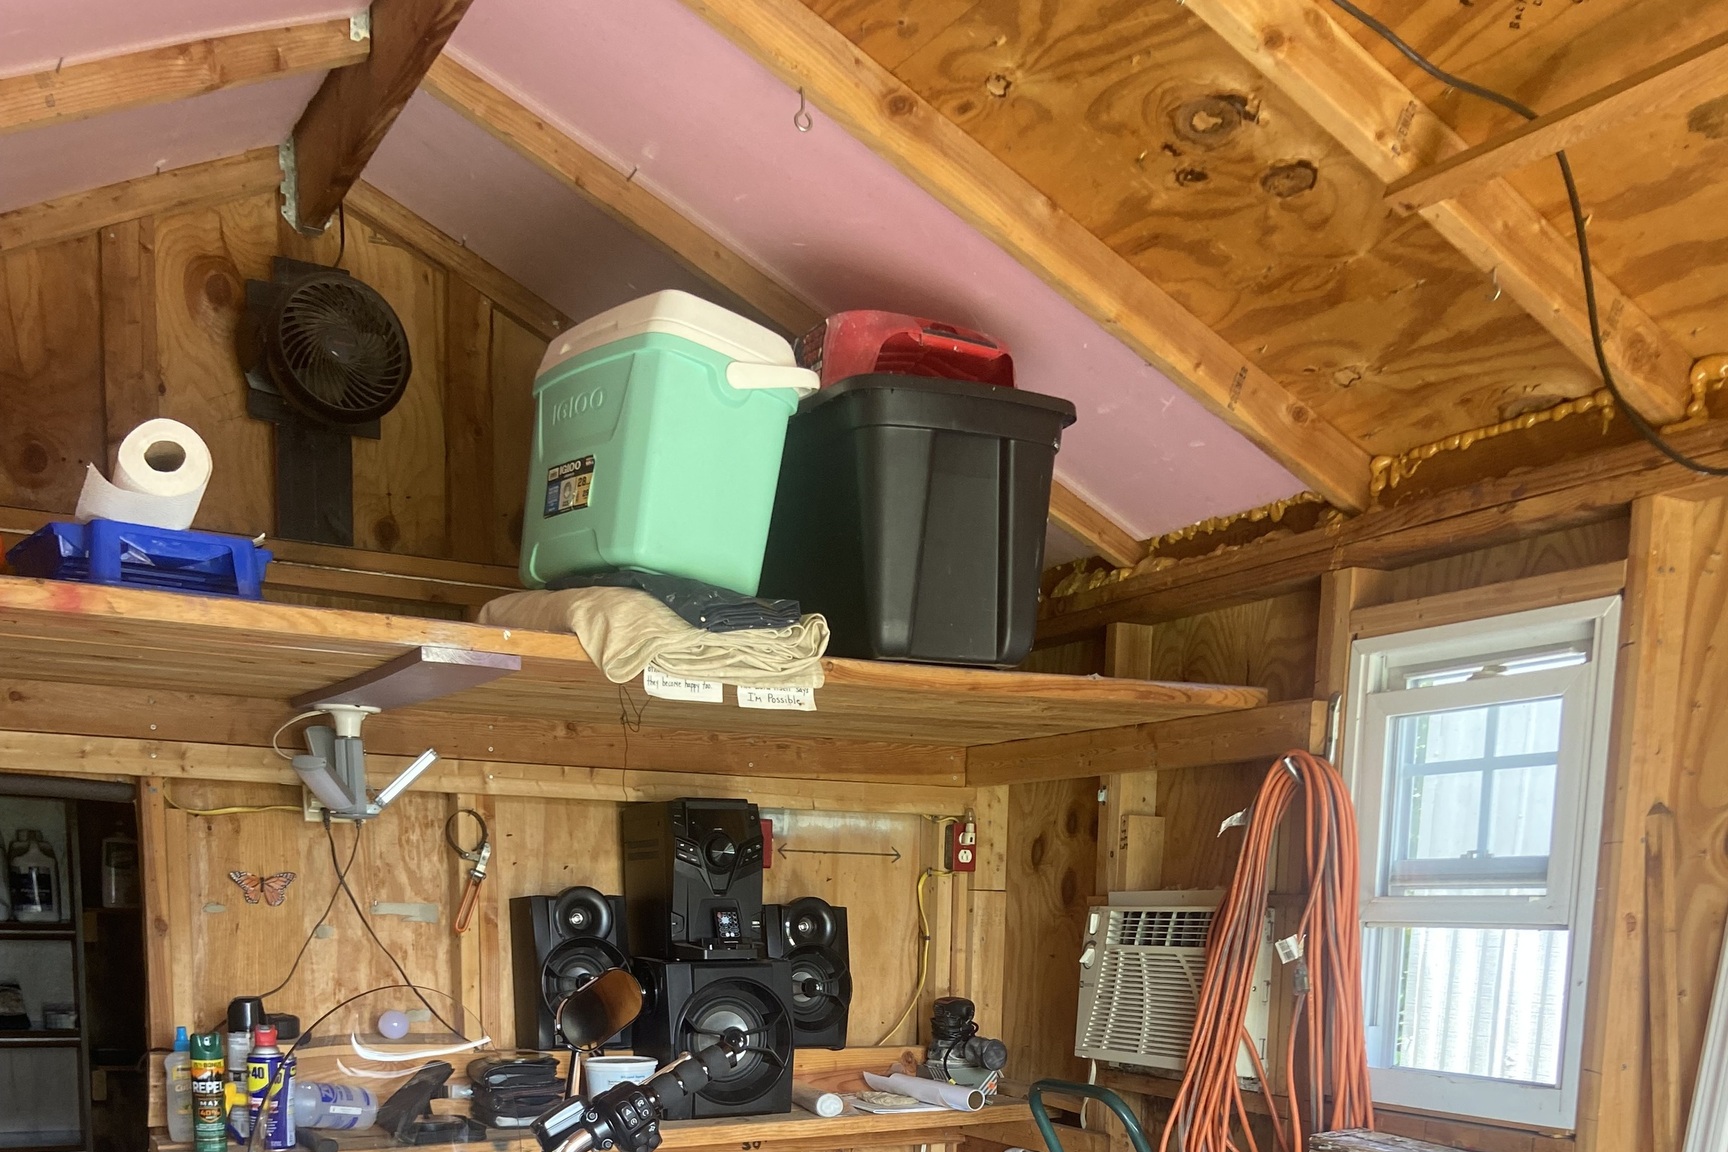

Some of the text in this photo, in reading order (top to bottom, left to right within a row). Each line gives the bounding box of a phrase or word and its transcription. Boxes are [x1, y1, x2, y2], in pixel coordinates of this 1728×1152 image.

[647, 675, 659, 689] they
[662, 676, 682, 688] become
[685, 679, 699, 693] happy
[192, 1081, 224, 1094] REPEL
